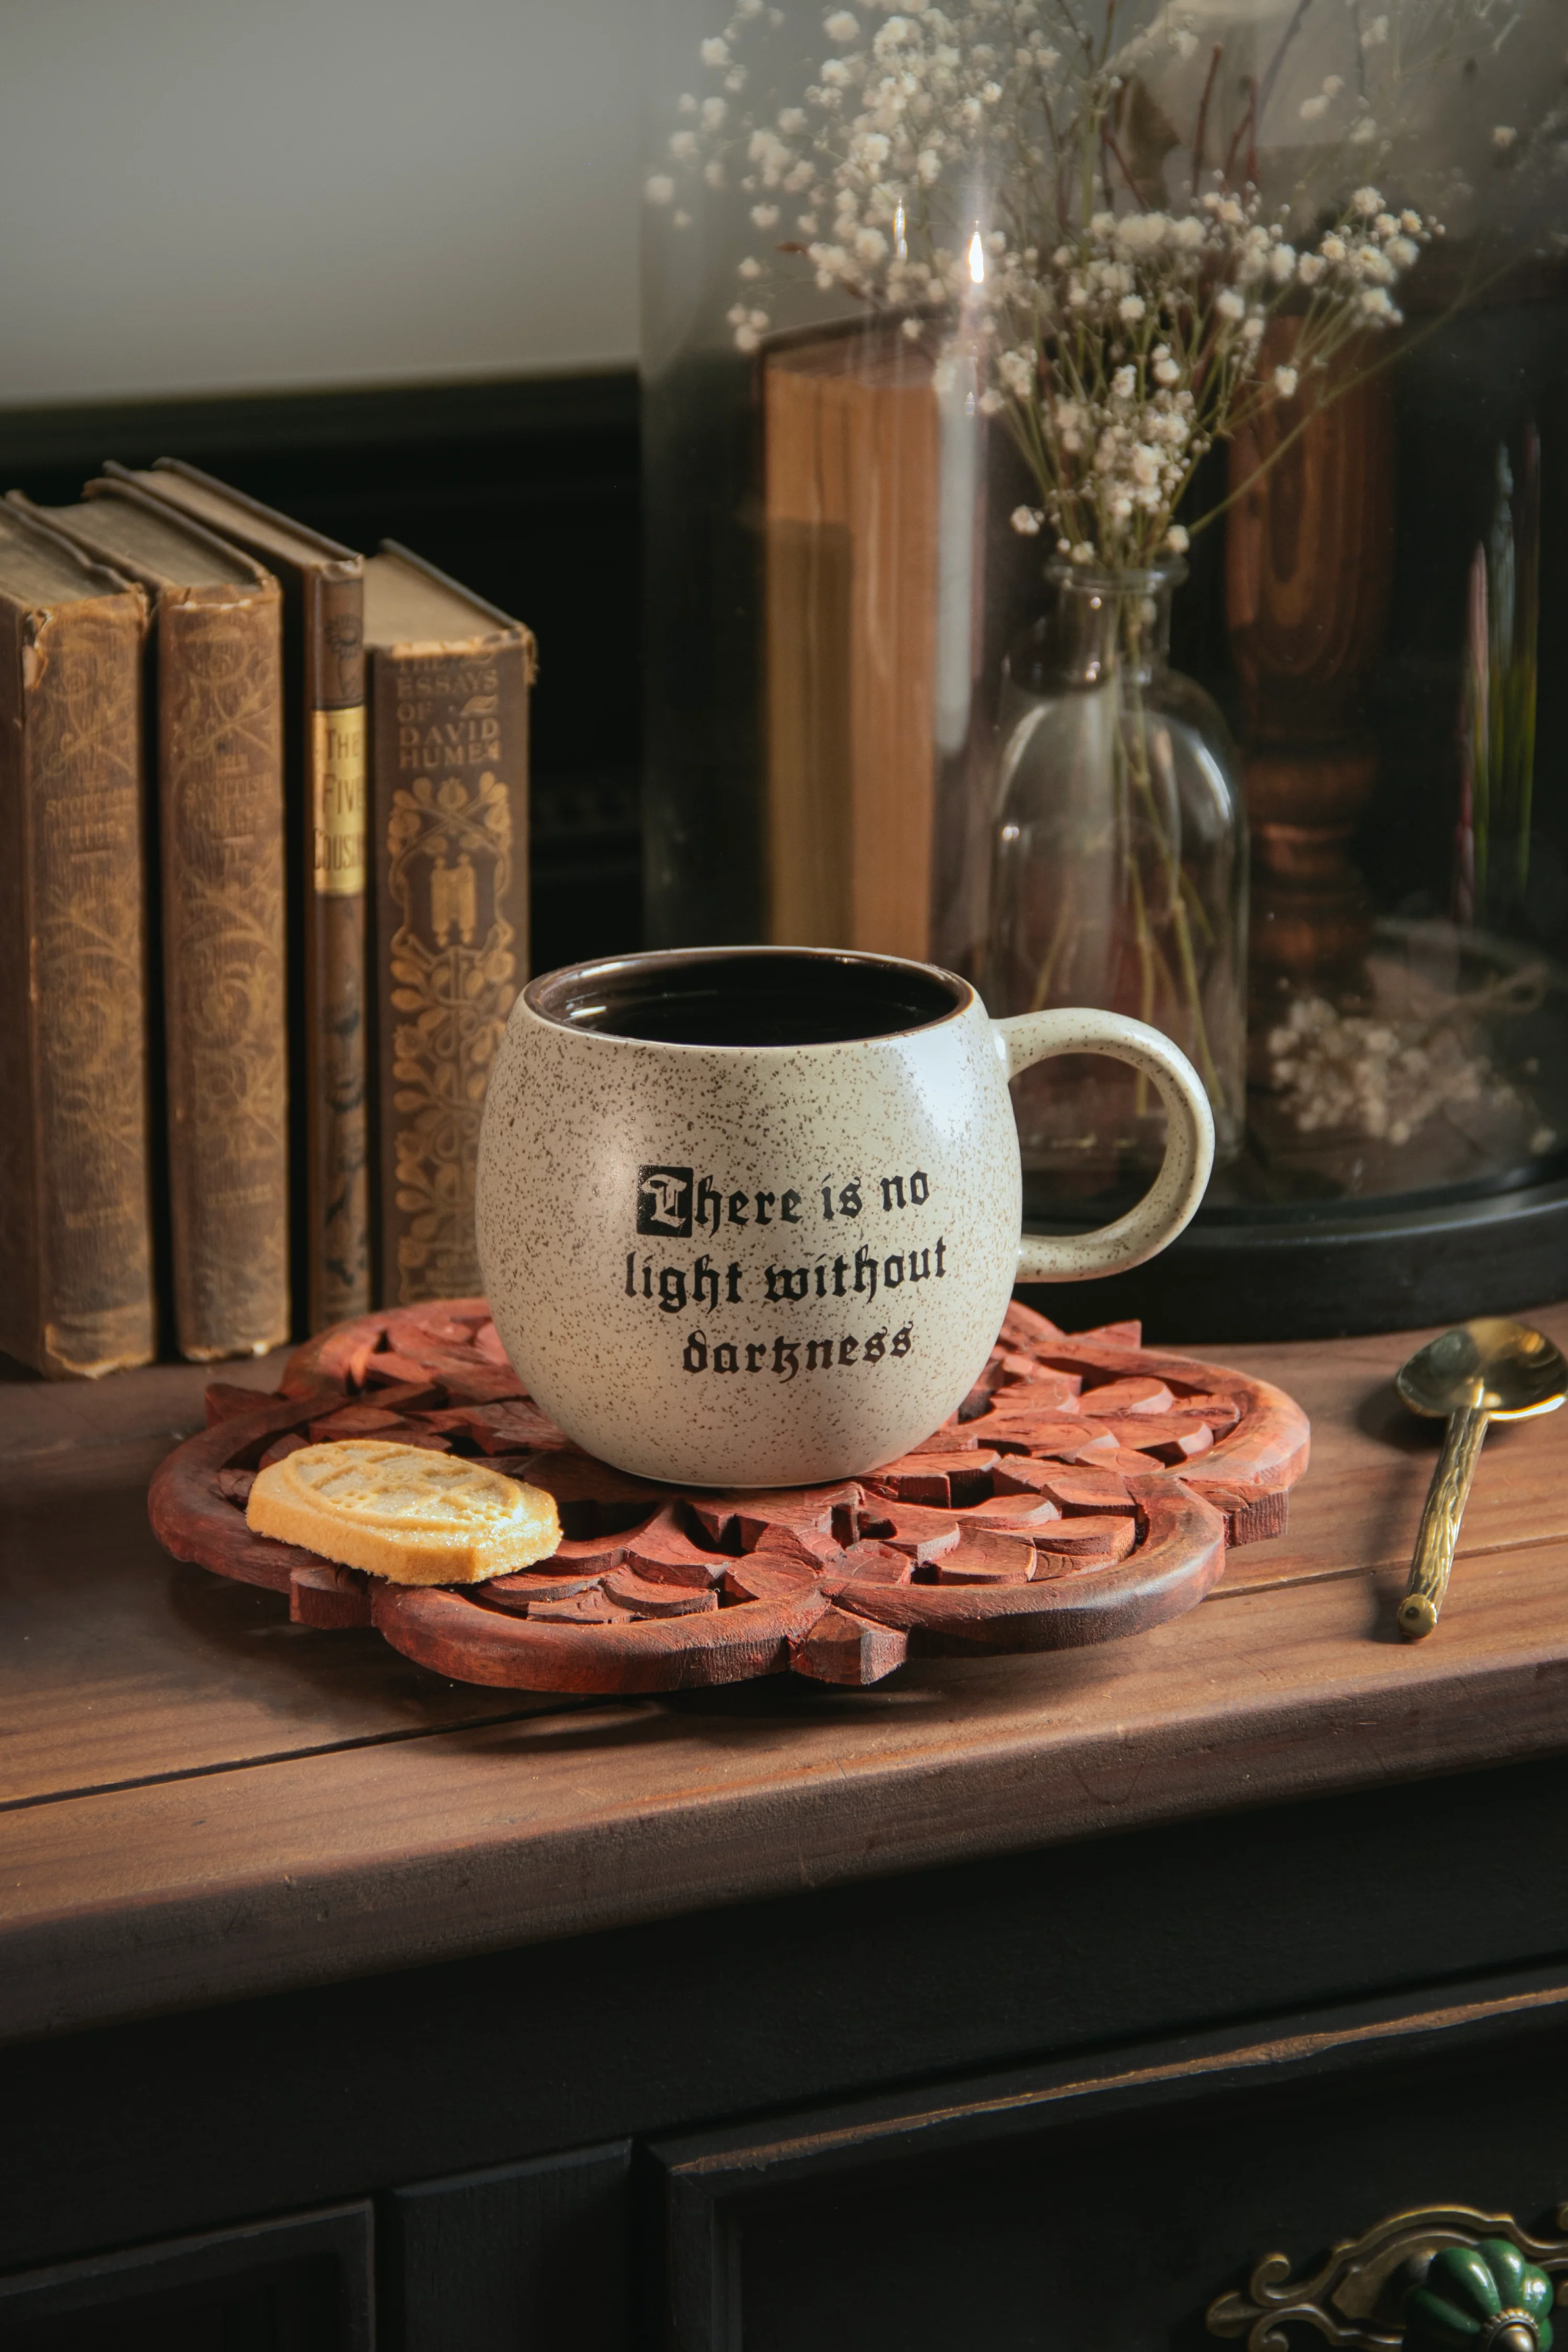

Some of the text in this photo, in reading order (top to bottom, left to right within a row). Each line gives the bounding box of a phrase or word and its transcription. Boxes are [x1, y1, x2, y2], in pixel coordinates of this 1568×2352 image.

[397, 669, 498, 699] ESSAYS
[397, 700, 433, 724] OF
[326, 729, 361, 759] THE
[399, 718, 500, 746] DAVID
[399, 742, 488, 770] HUME
[636, 1165, 929, 1238] There is no
[625, 1237, 947, 1315] light without
[683, 1321, 914, 1383] darkness
